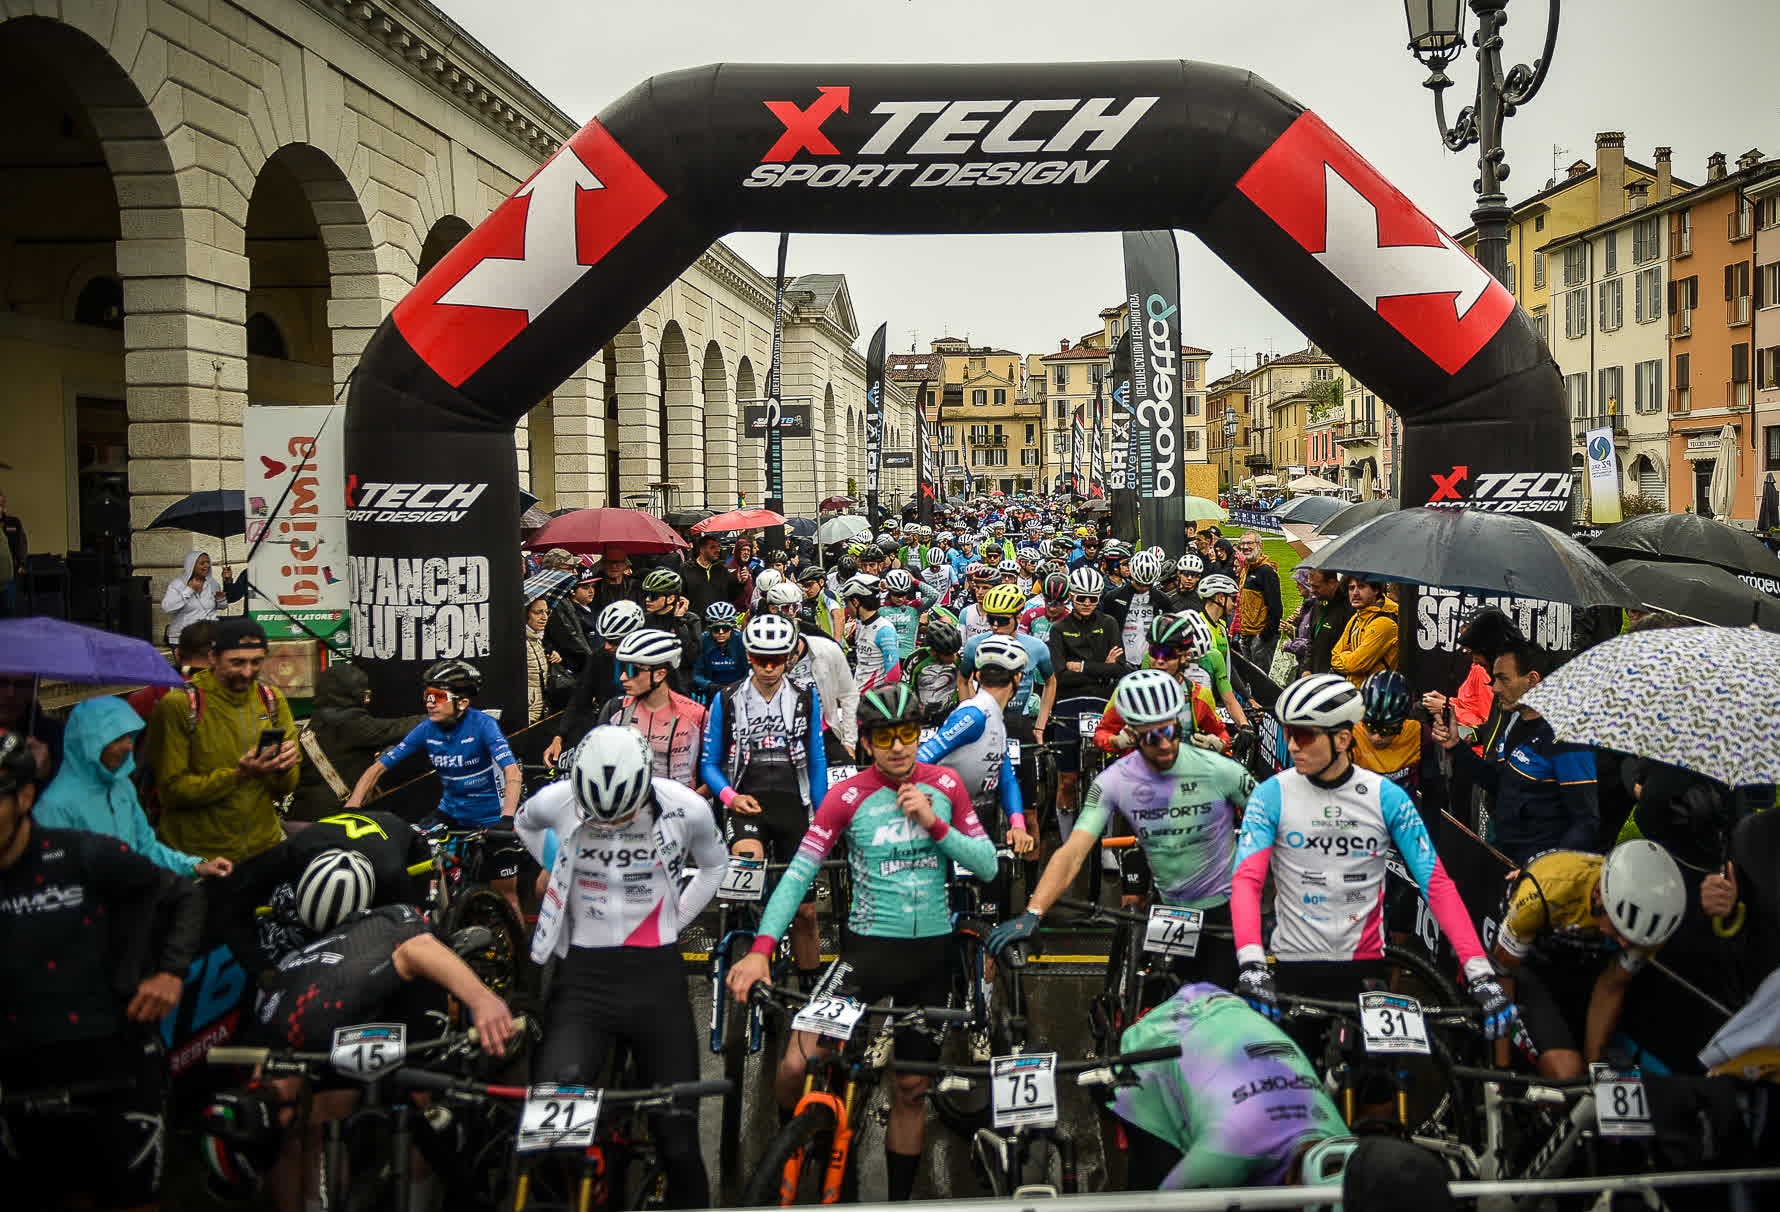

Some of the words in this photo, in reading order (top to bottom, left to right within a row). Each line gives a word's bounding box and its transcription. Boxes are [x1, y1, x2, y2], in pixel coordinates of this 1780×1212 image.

[742, 163, 919, 188] SPORT
[909, 159, 1110, 187] DESIGN
[1110, 412, 1131, 490] BRIXI
[357, 482, 489, 509] TECH
[1498, 500, 1568, 513] DESIGN
[277, 436, 320, 607] bicimia
[346, 510, 378, 523] PORT
[375, 510, 468, 523] DESIGN
[348, 556, 490, 606] DVANCED
[349, 603, 491, 661] OLUTION
[832, 769, 848, 782] 54
[1130, 802, 1212, 820] TRISPORTS
[731, 870, 754, 889] 72
[1162, 920, 1186, 943] 74
[813, 999, 846, 1019] 23
[1380, 1009, 1408, 1037] 31
[351, 1043, 386, 1073] 15
[1008, 1073, 1038, 1106] 75
[1613, 1085, 1645, 1116] 81
[540, 1101, 576, 1128] 21
